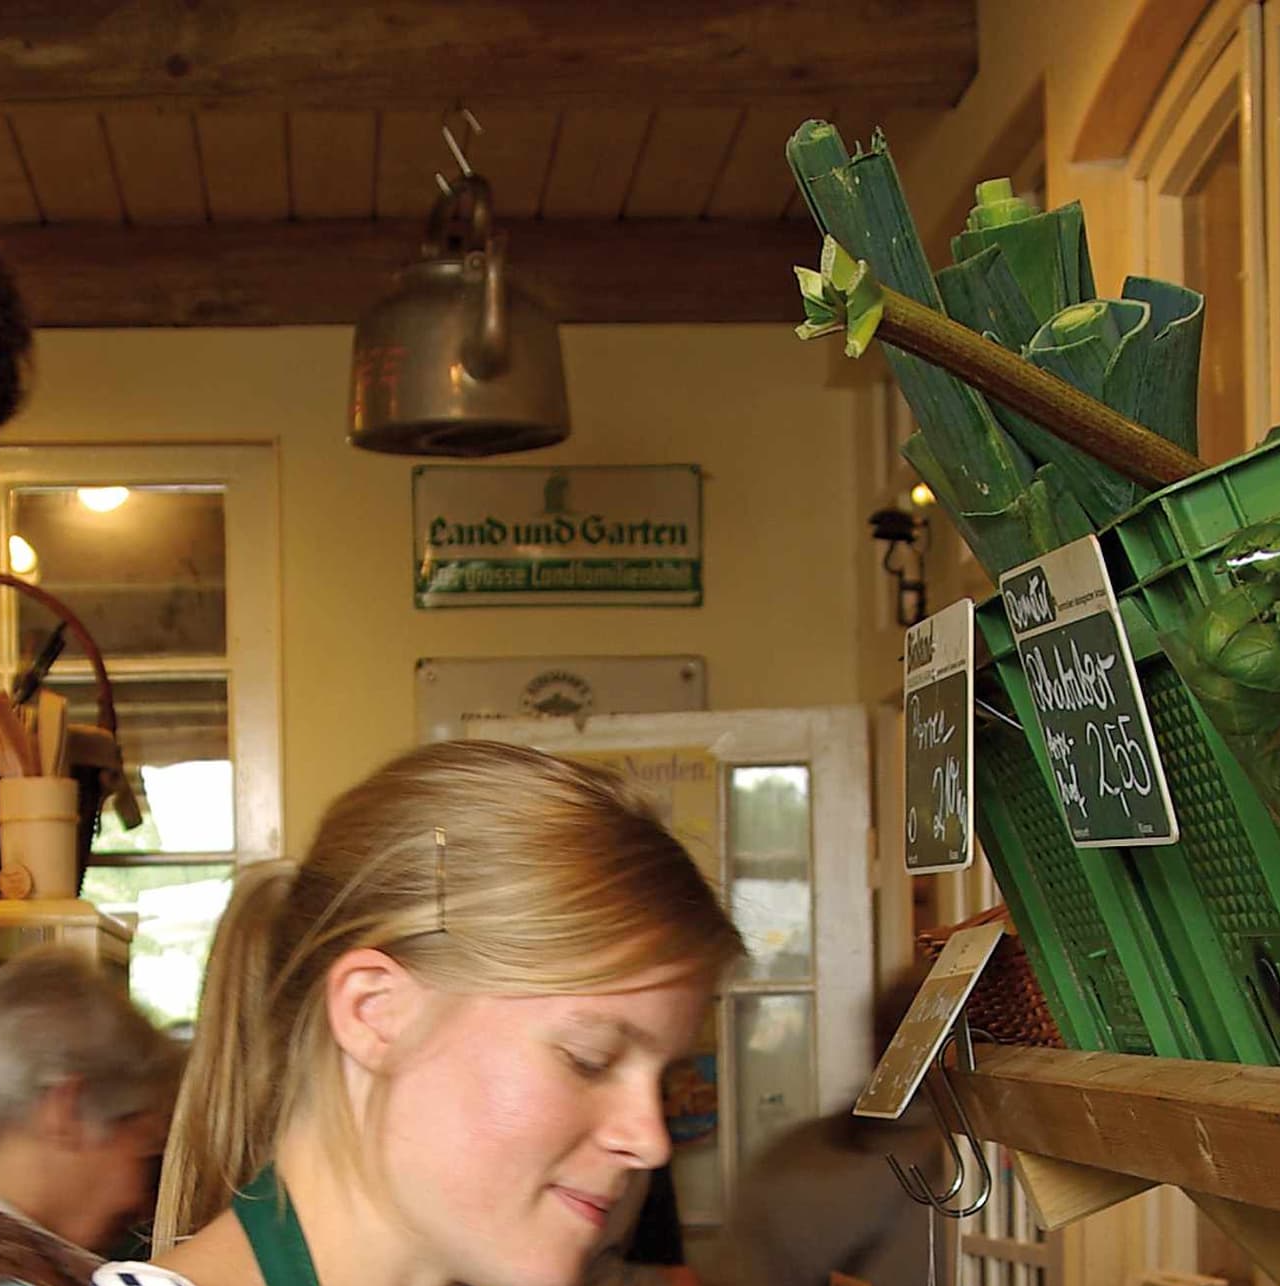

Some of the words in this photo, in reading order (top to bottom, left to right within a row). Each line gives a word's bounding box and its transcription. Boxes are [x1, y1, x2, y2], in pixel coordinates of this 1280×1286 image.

[430, 515, 507, 546] Land
[513, 514, 575, 545] und
[580, 514, 688, 545] Garten
